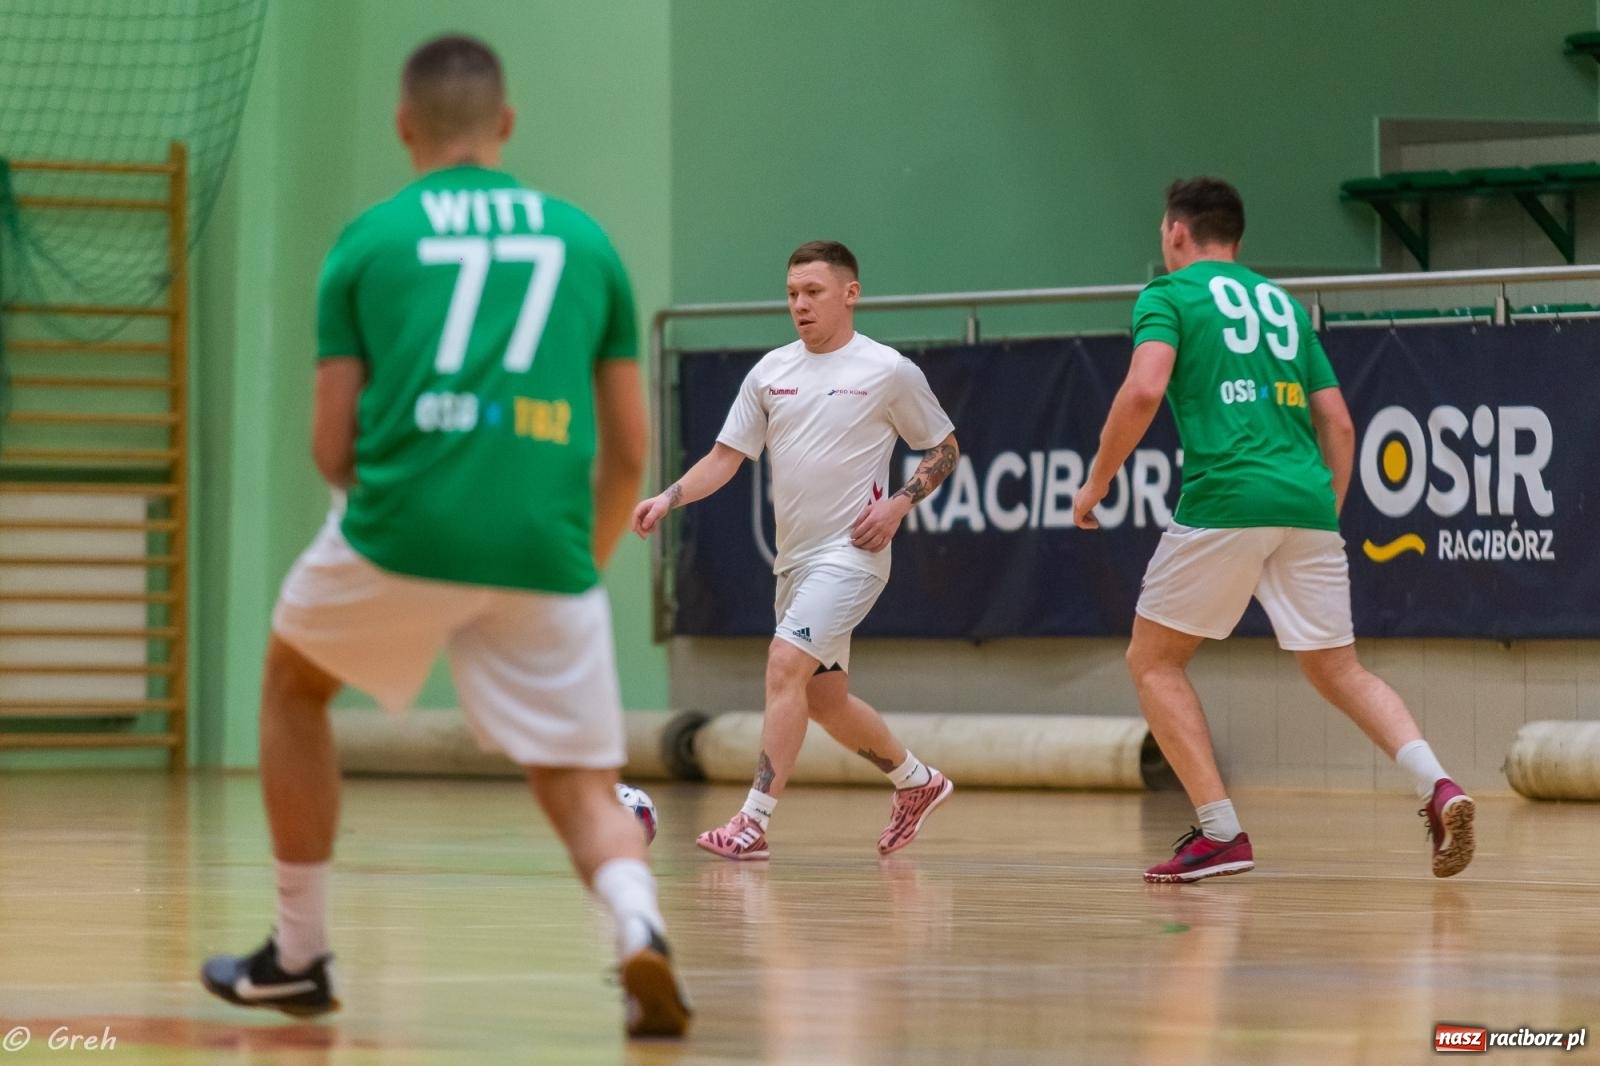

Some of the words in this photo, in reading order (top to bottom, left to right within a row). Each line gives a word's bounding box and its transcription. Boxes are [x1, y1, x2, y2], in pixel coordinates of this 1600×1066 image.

[420, 188, 545, 234] WITT
[417, 234, 566, 374] 77
[1208, 275, 1300, 361] 99
[768, 387, 799, 396] hummel
[1220, 379, 1257, 405] OSG
[1438, 520, 1556, 561] RACIBÓRZ
